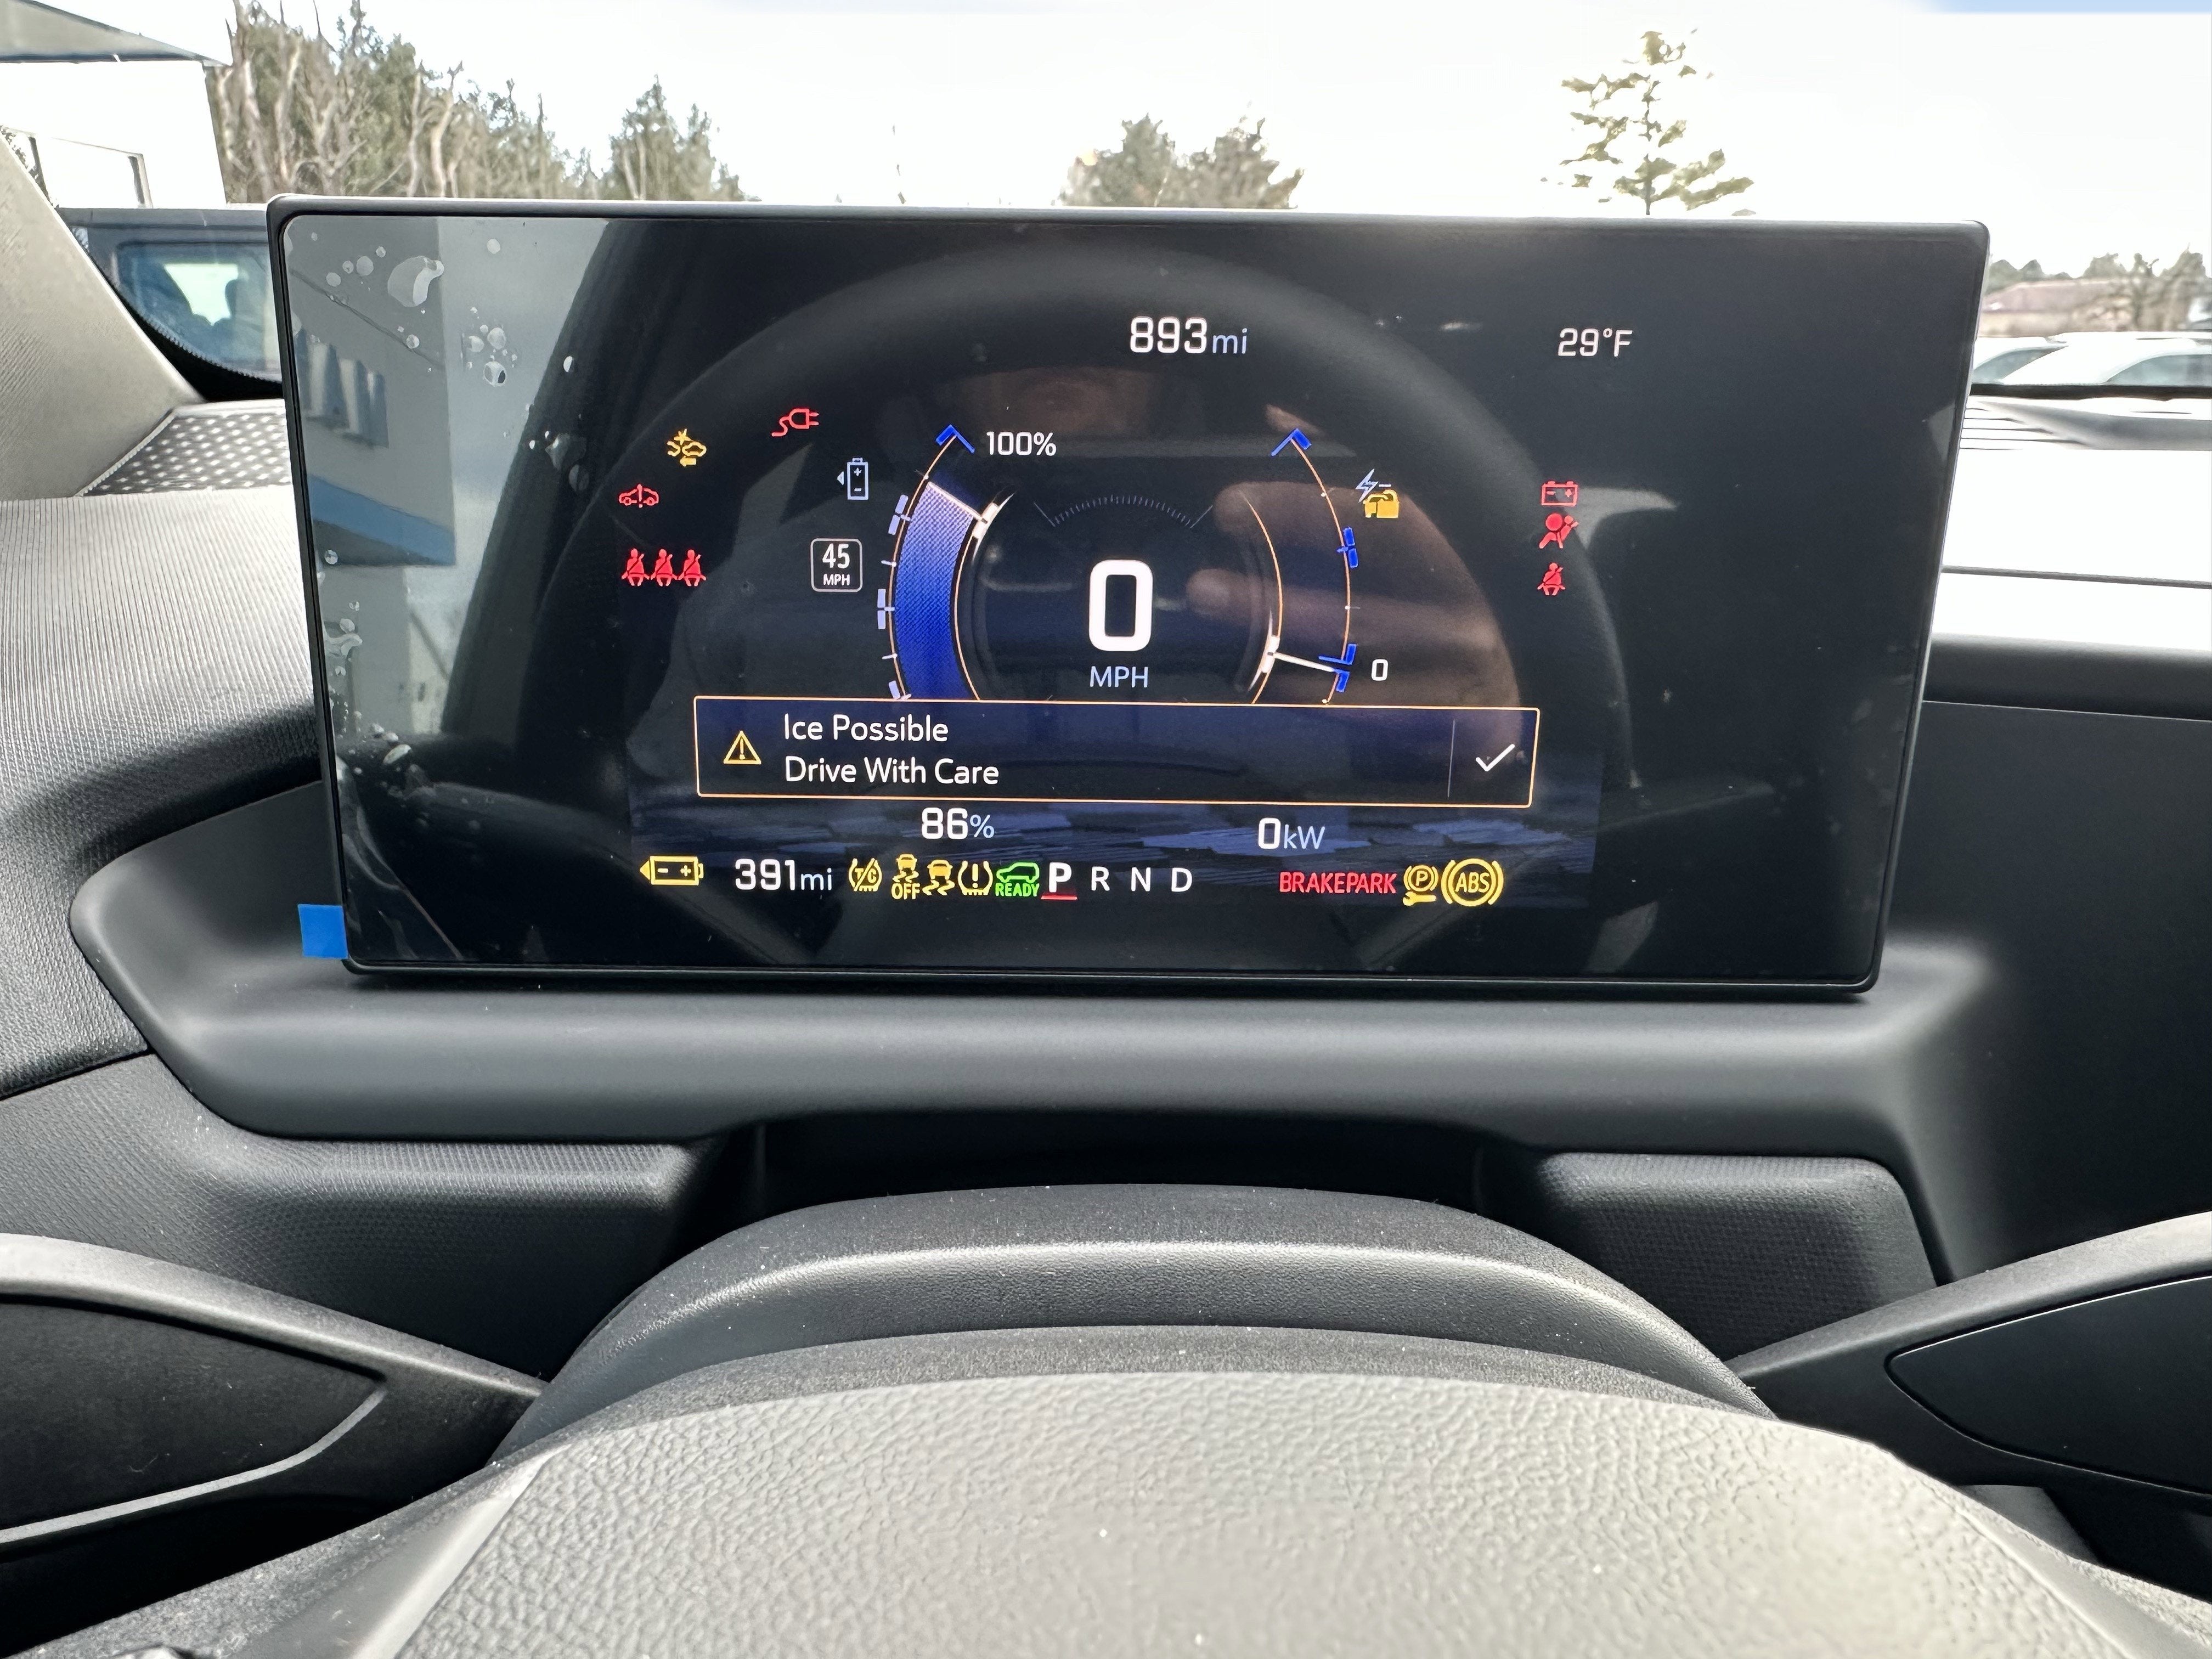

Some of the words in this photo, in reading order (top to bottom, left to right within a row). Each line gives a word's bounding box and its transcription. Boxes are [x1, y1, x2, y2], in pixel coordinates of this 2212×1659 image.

[1558, 328, 1633, 357] 29°F
[986, 431, 1057, 456] 100%
[822, 543, 851, 569] 45
[823, 573, 850, 586] MPH
[1088, 560, 1153, 652] 0
[1090, 665, 1148, 688] MPH
[1371, 659, 1389, 681] 0
[785, 713, 823, 740] Ice
[833, 713, 949, 742] Possible
[785, 755, 857, 783] Drive
[864, 757, 926, 783] With
[934, 758, 999, 785] Care
[921, 807, 995, 839] 86%
[995, 882, 1040, 897] READY
[1048, 862, 1072, 893] P
[1091, 866, 1110, 891] R
[1131, 867, 1151, 891] N
[1171, 867, 1193, 892] D
[1455, 872, 1490, 893] ABS
[891, 883, 921, 900] OFF
